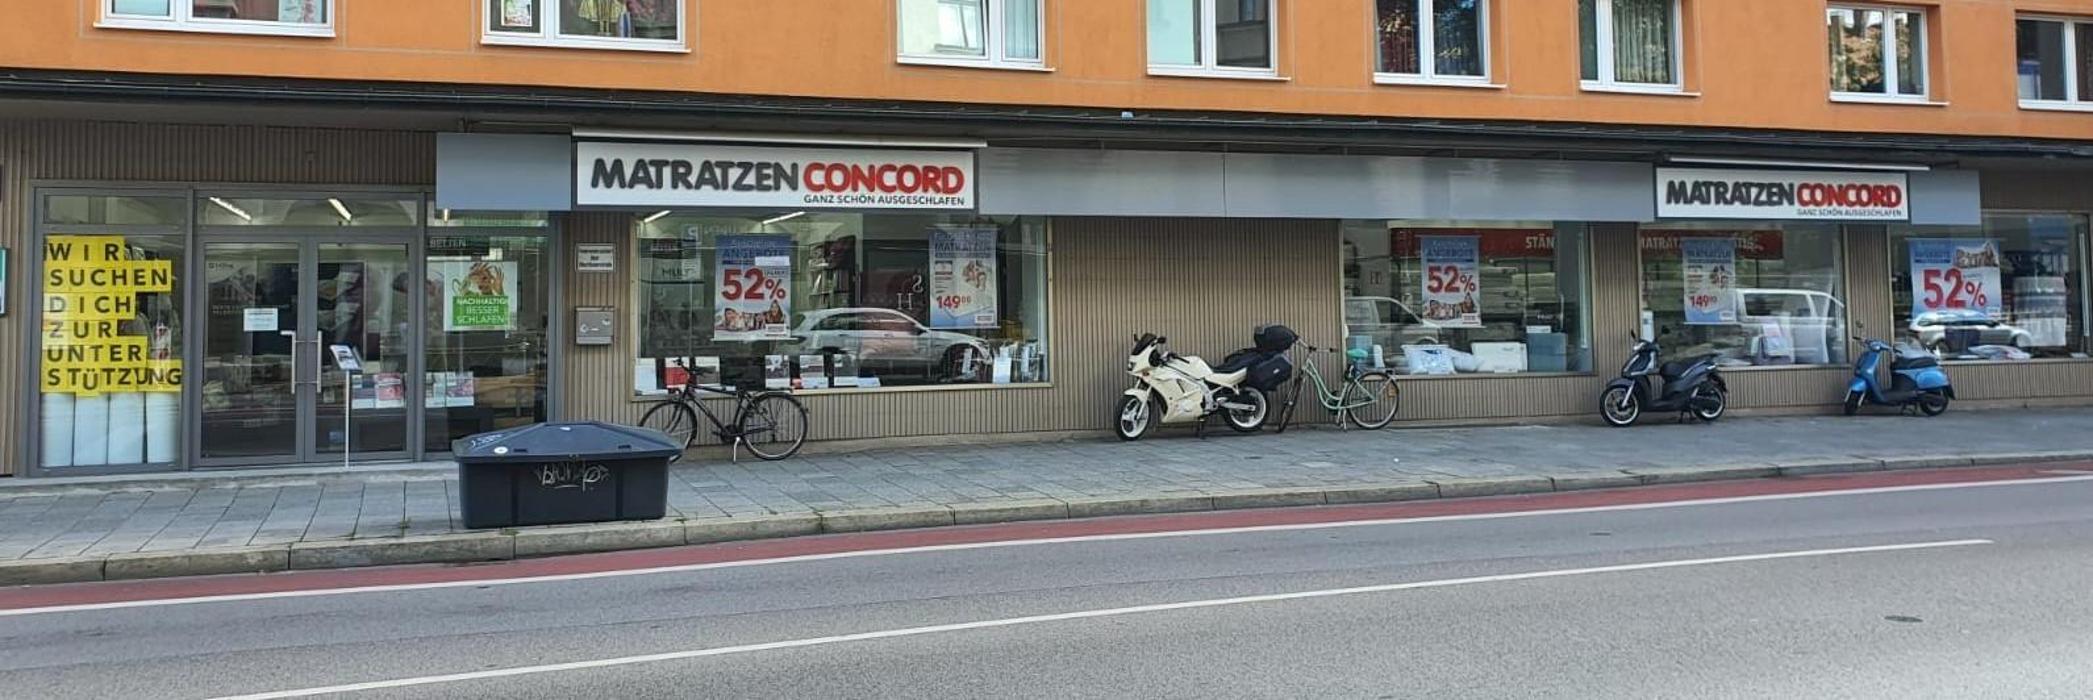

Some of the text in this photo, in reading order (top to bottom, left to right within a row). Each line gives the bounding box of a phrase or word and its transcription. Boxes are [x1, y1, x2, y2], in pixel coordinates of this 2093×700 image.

[591, 158, 964, 194] MATRATZEN CONCORD
[803, 193, 965, 206] GANZ SCHÖN AUSGESCHLAFEN
[1666, 181, 1902, 208] MATRATZEN CONCORD
[1819, 208, 1843, 217] SCHÖN
[1844, 209, 1902, 217] AUSGESCHLAFEN
[49, 242, 119, 261] WIR
[50, 269, 168, 286] SUCHEN
[721, 267, 786, 300] 52%
[1427, 265, 1477, 293] 52%
[1923, 267, 1987, 309] 52%
[50, 296, 131, 313] DICH
[456, 316, 505, 325] SCHLAFEN
[49, 321, 112, 339] ZUR
[47, 345, 142, 362] UNTER
[47, 367, 182, 390] STÜTZUNG
